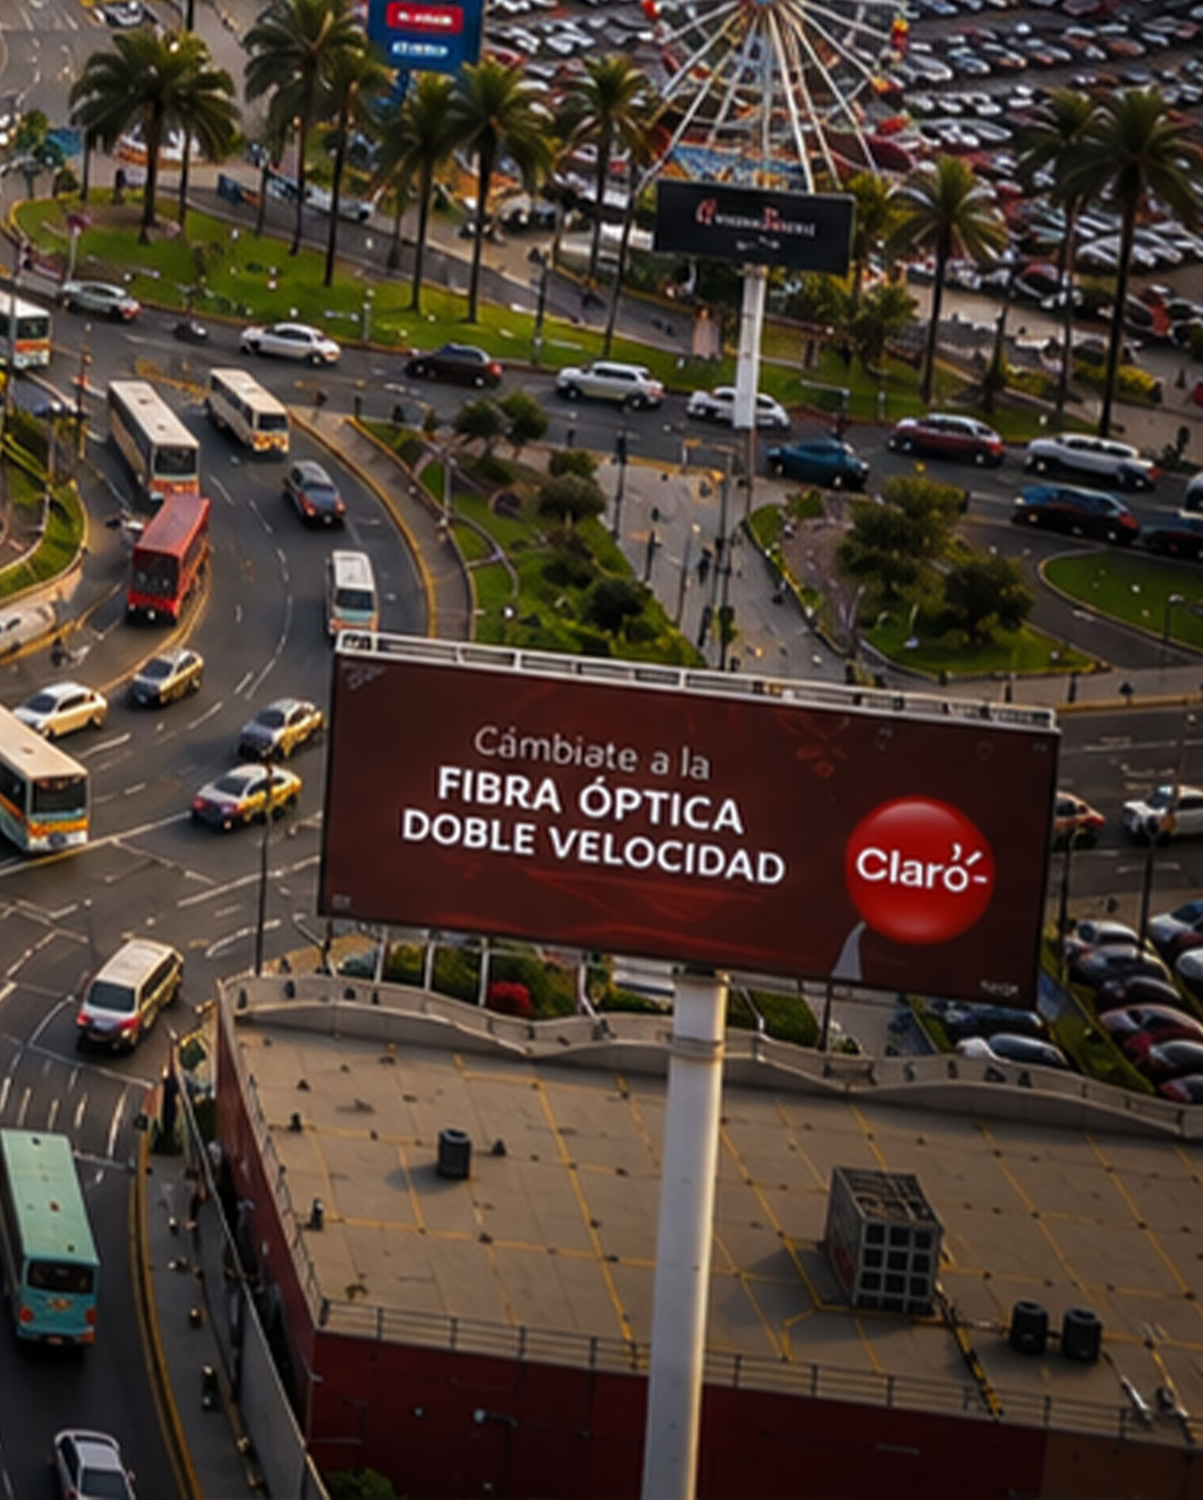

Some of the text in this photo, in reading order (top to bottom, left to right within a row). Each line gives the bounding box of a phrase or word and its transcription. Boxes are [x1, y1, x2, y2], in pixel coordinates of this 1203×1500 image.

[473, 725, 710, 781] Cámbiate a la
[437, 765, 744, 835] FIBRA ÓPTICA
[402, 808, 786, 885] DOBLE VELOCIDAD
[856, 843, 971, 892] Claro
